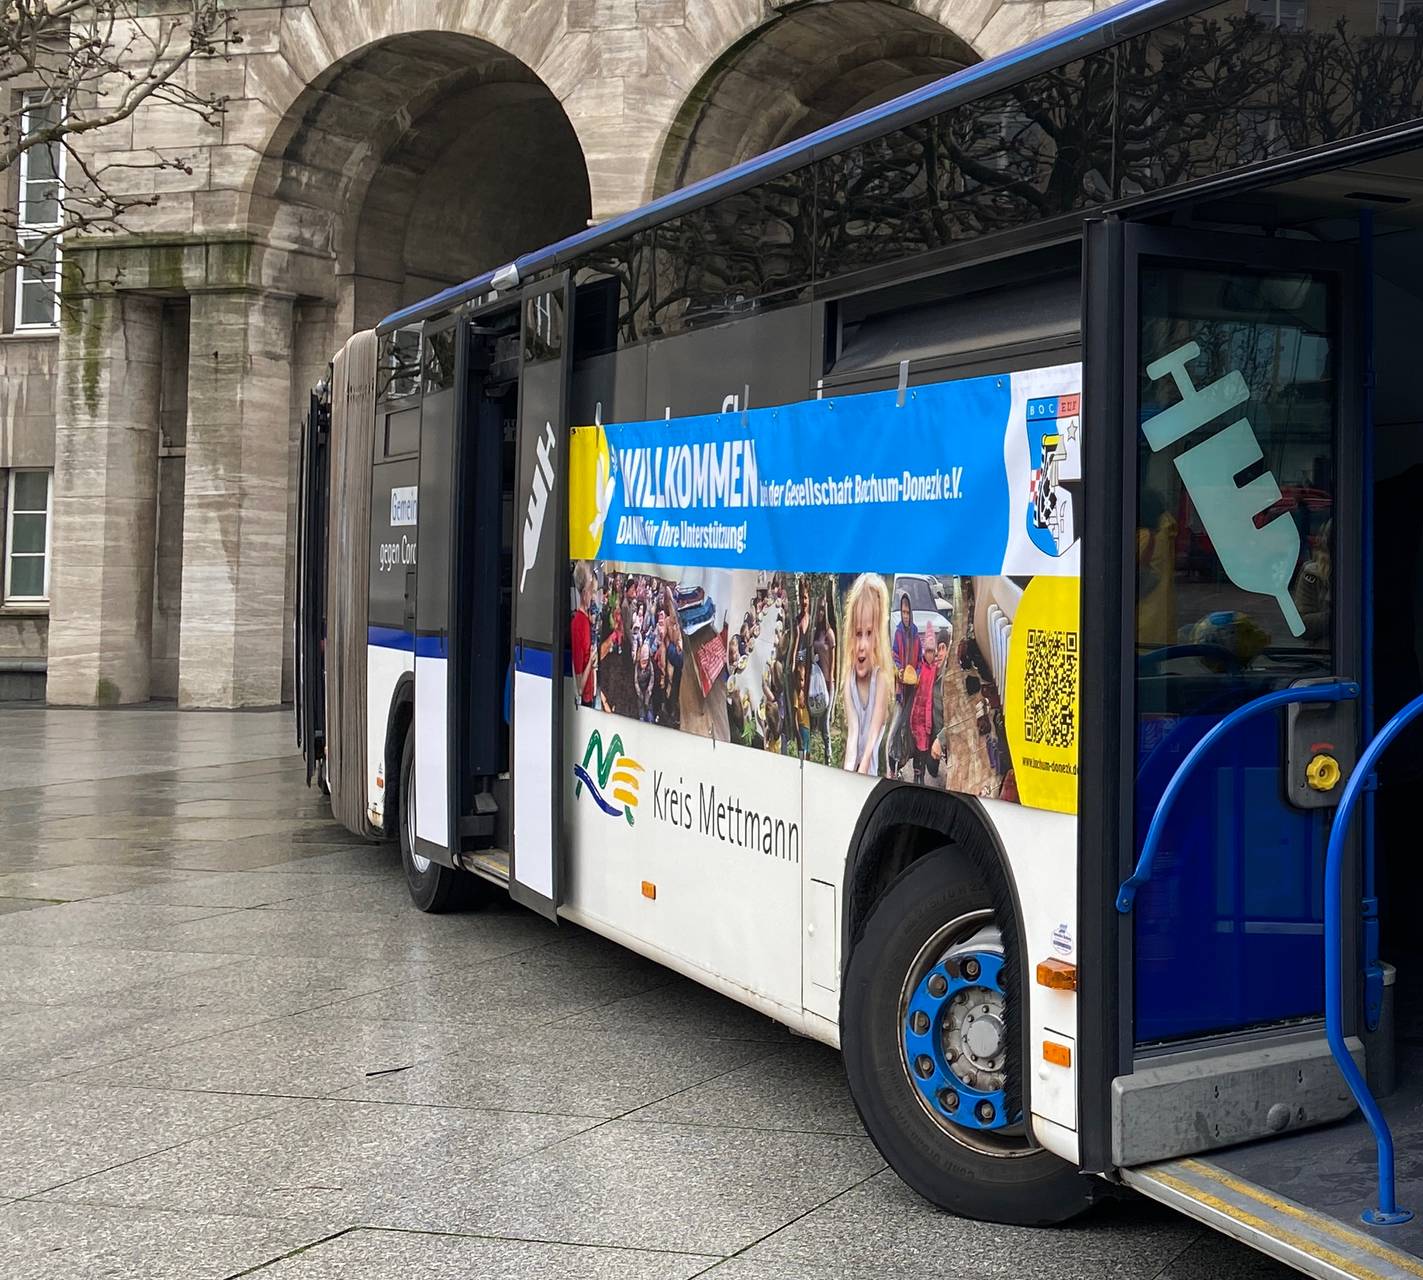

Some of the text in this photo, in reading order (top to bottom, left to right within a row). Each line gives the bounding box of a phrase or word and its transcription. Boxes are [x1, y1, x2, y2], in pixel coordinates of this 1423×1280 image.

[619, 438, 759, 510] WILLKOMMEN
[768, 479, 785, 507] der
[785, 475, 853, 506] Gesellschaft
[943, 466, 964, 501] e.V.
[657, 519, 680, 548] Ihre
[680, 519, 747, 554] Unterstützung!
[653, 770, 799, 864] Kreis Mettmann
